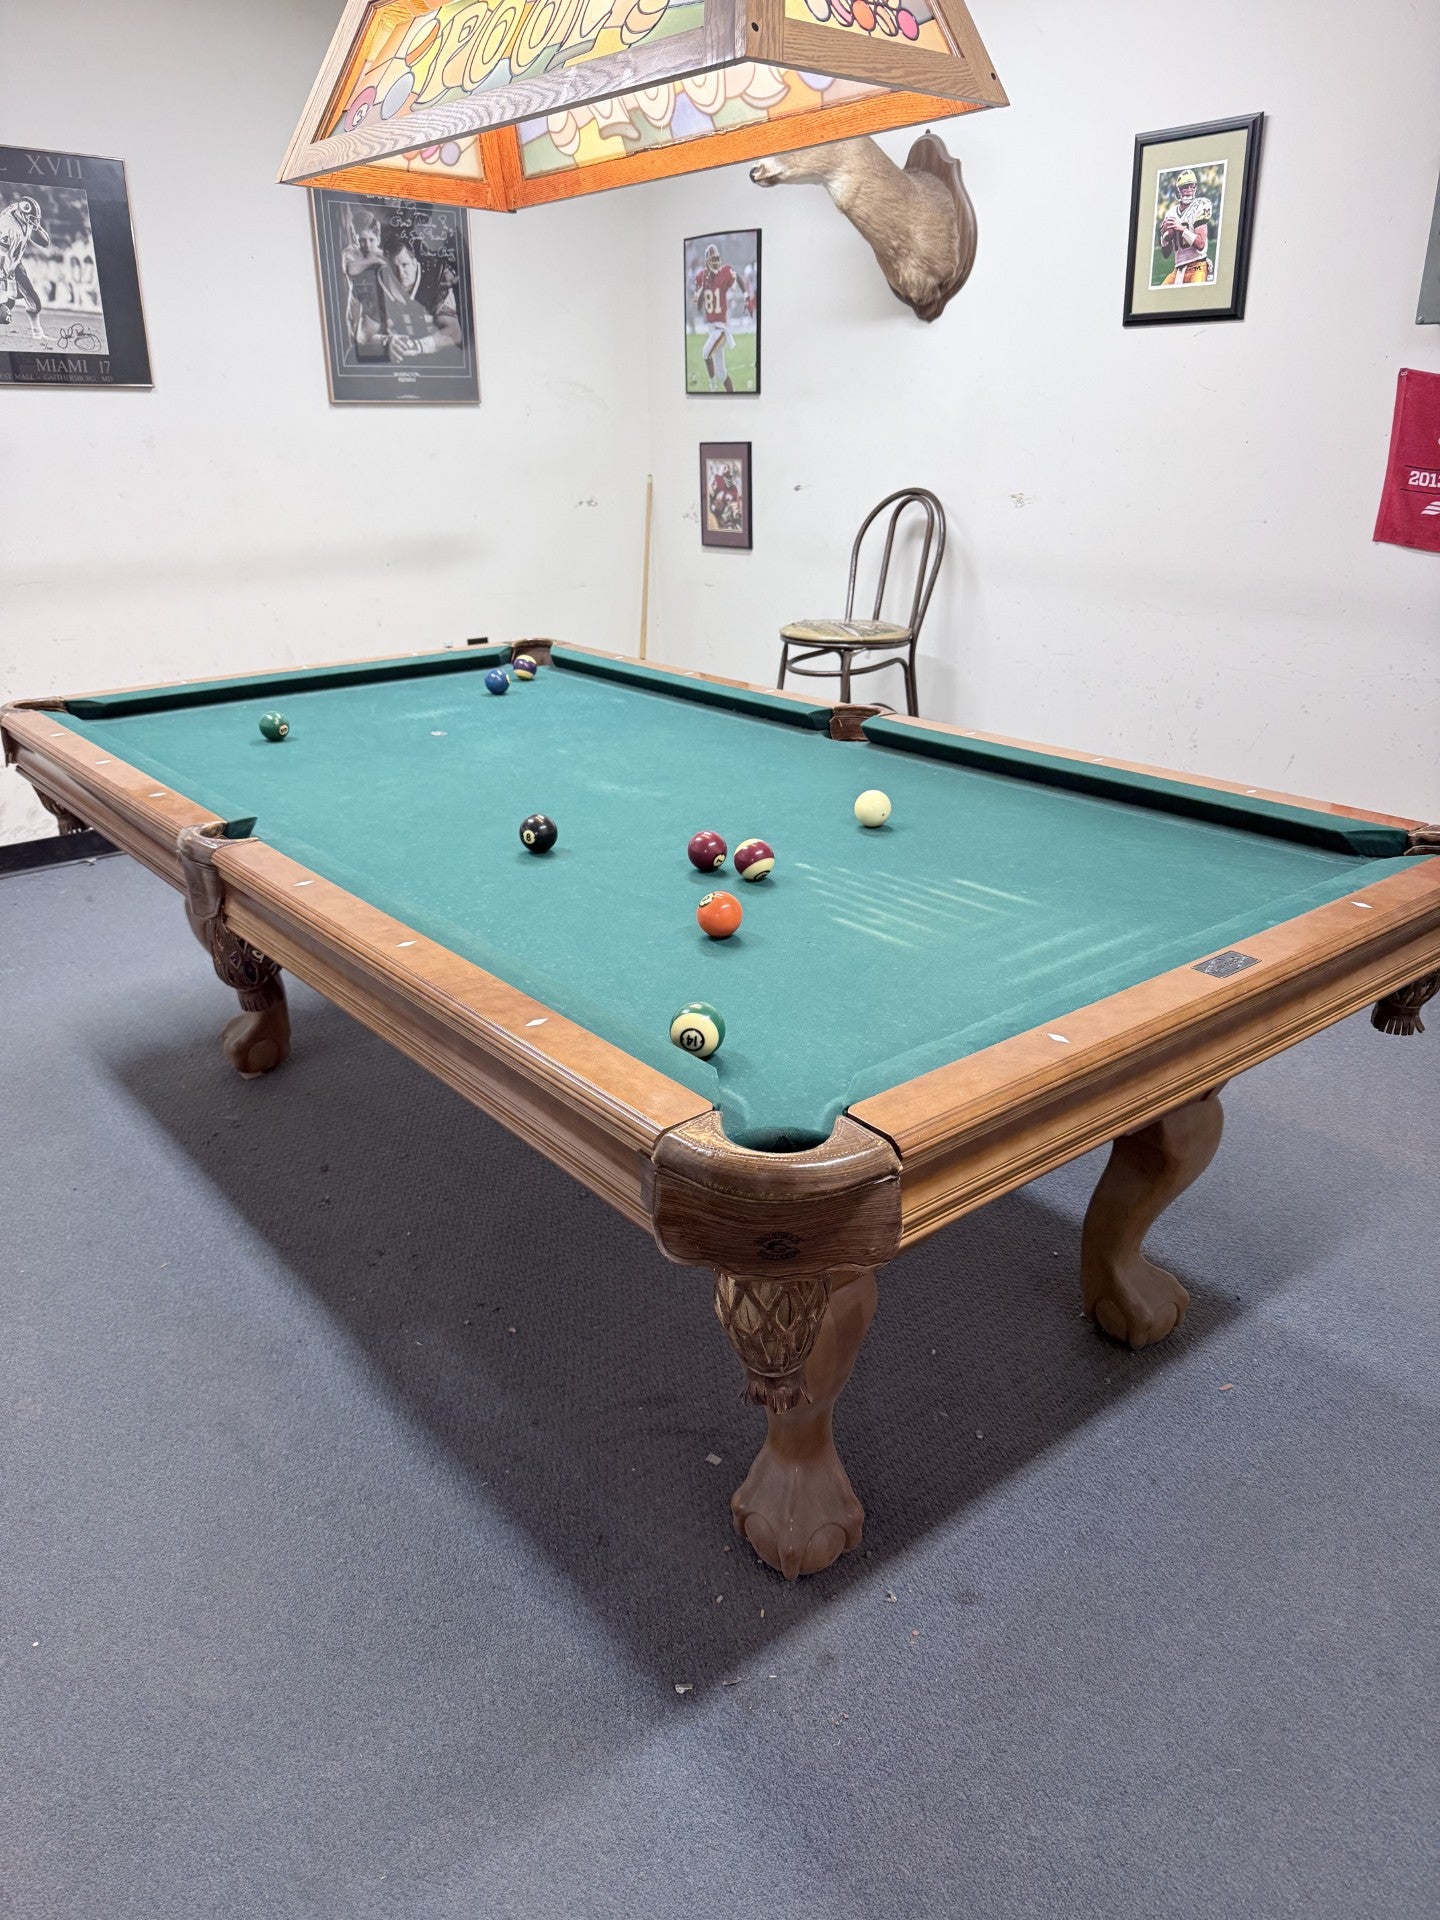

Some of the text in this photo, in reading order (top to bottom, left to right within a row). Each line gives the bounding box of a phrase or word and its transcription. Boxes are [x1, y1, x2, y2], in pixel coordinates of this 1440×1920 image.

[25, 154, 83, 179] XVII
[704, 288, 722, 314] 81
[36, 358, 111, 374] MIAMI 17
[526, 833, 531, 841] 8
[686, 1034, 698, 1047] 14
